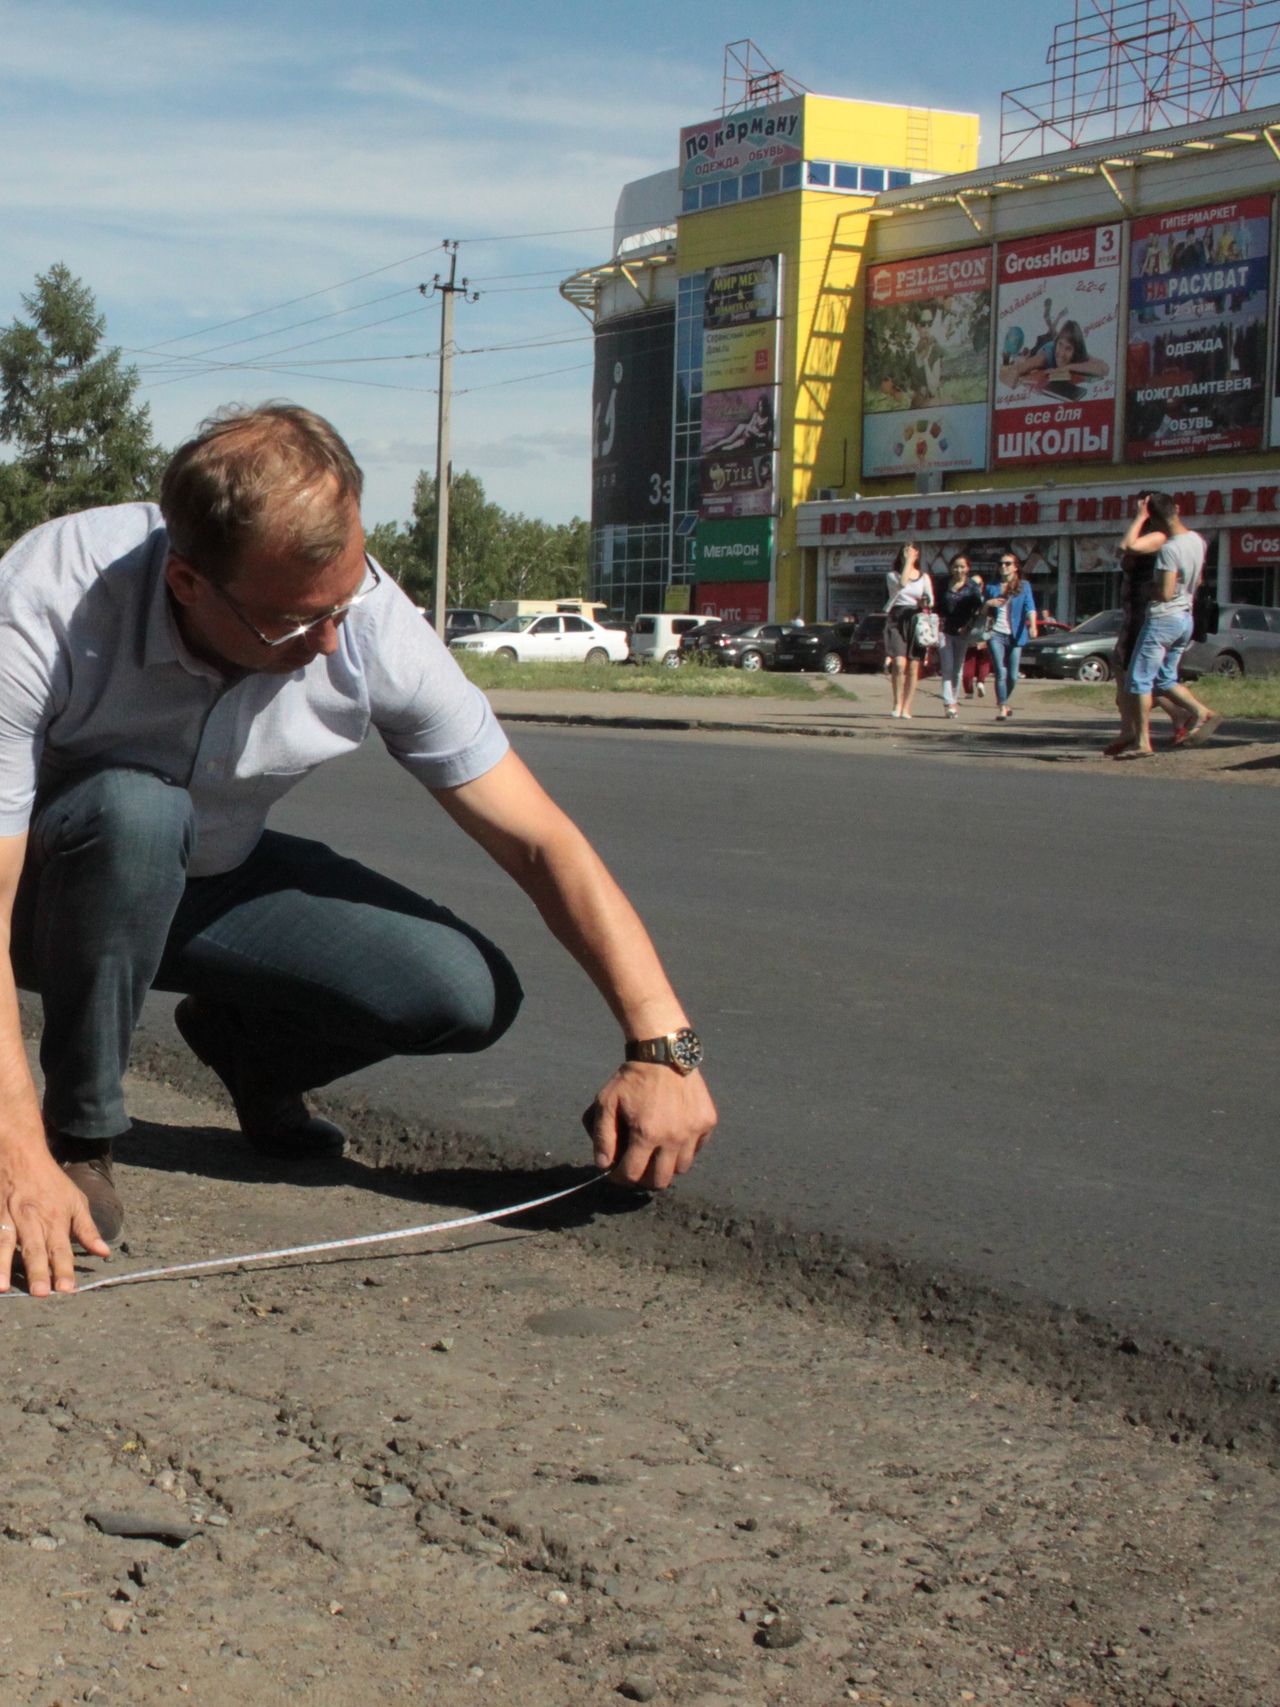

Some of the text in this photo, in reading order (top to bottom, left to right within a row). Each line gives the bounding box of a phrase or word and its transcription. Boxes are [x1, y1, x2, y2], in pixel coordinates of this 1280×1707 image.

[685, 114, 798, 160] По карману
[695, 145, 784, 175] ОДЕЖДА ОБУВЬ
[1160, 205, 1237, 230] ГИПЕРМАРКЕТ
[1101, 230, 1114, 252] 3
[1005, 245, 1090, 274] GrossHaus
[1145, 266, 1249, 301] НАРАСХВАТ
[1165, 337, 1223, 358] ОДЕЖДА
[1136, 377, 1252, 403] КОЖГАЛАНТЕРЕЯ
[1025, 406, 1082, 425] все для
[1169, 417, 1213, 431] ОБУВЬ
[998, 425, 1109, 458] ШКОЛЫ
[820, 493, 1039, 536] ПРОДУКТОВЫЙ
[720, 608, 741, 621] МТС
